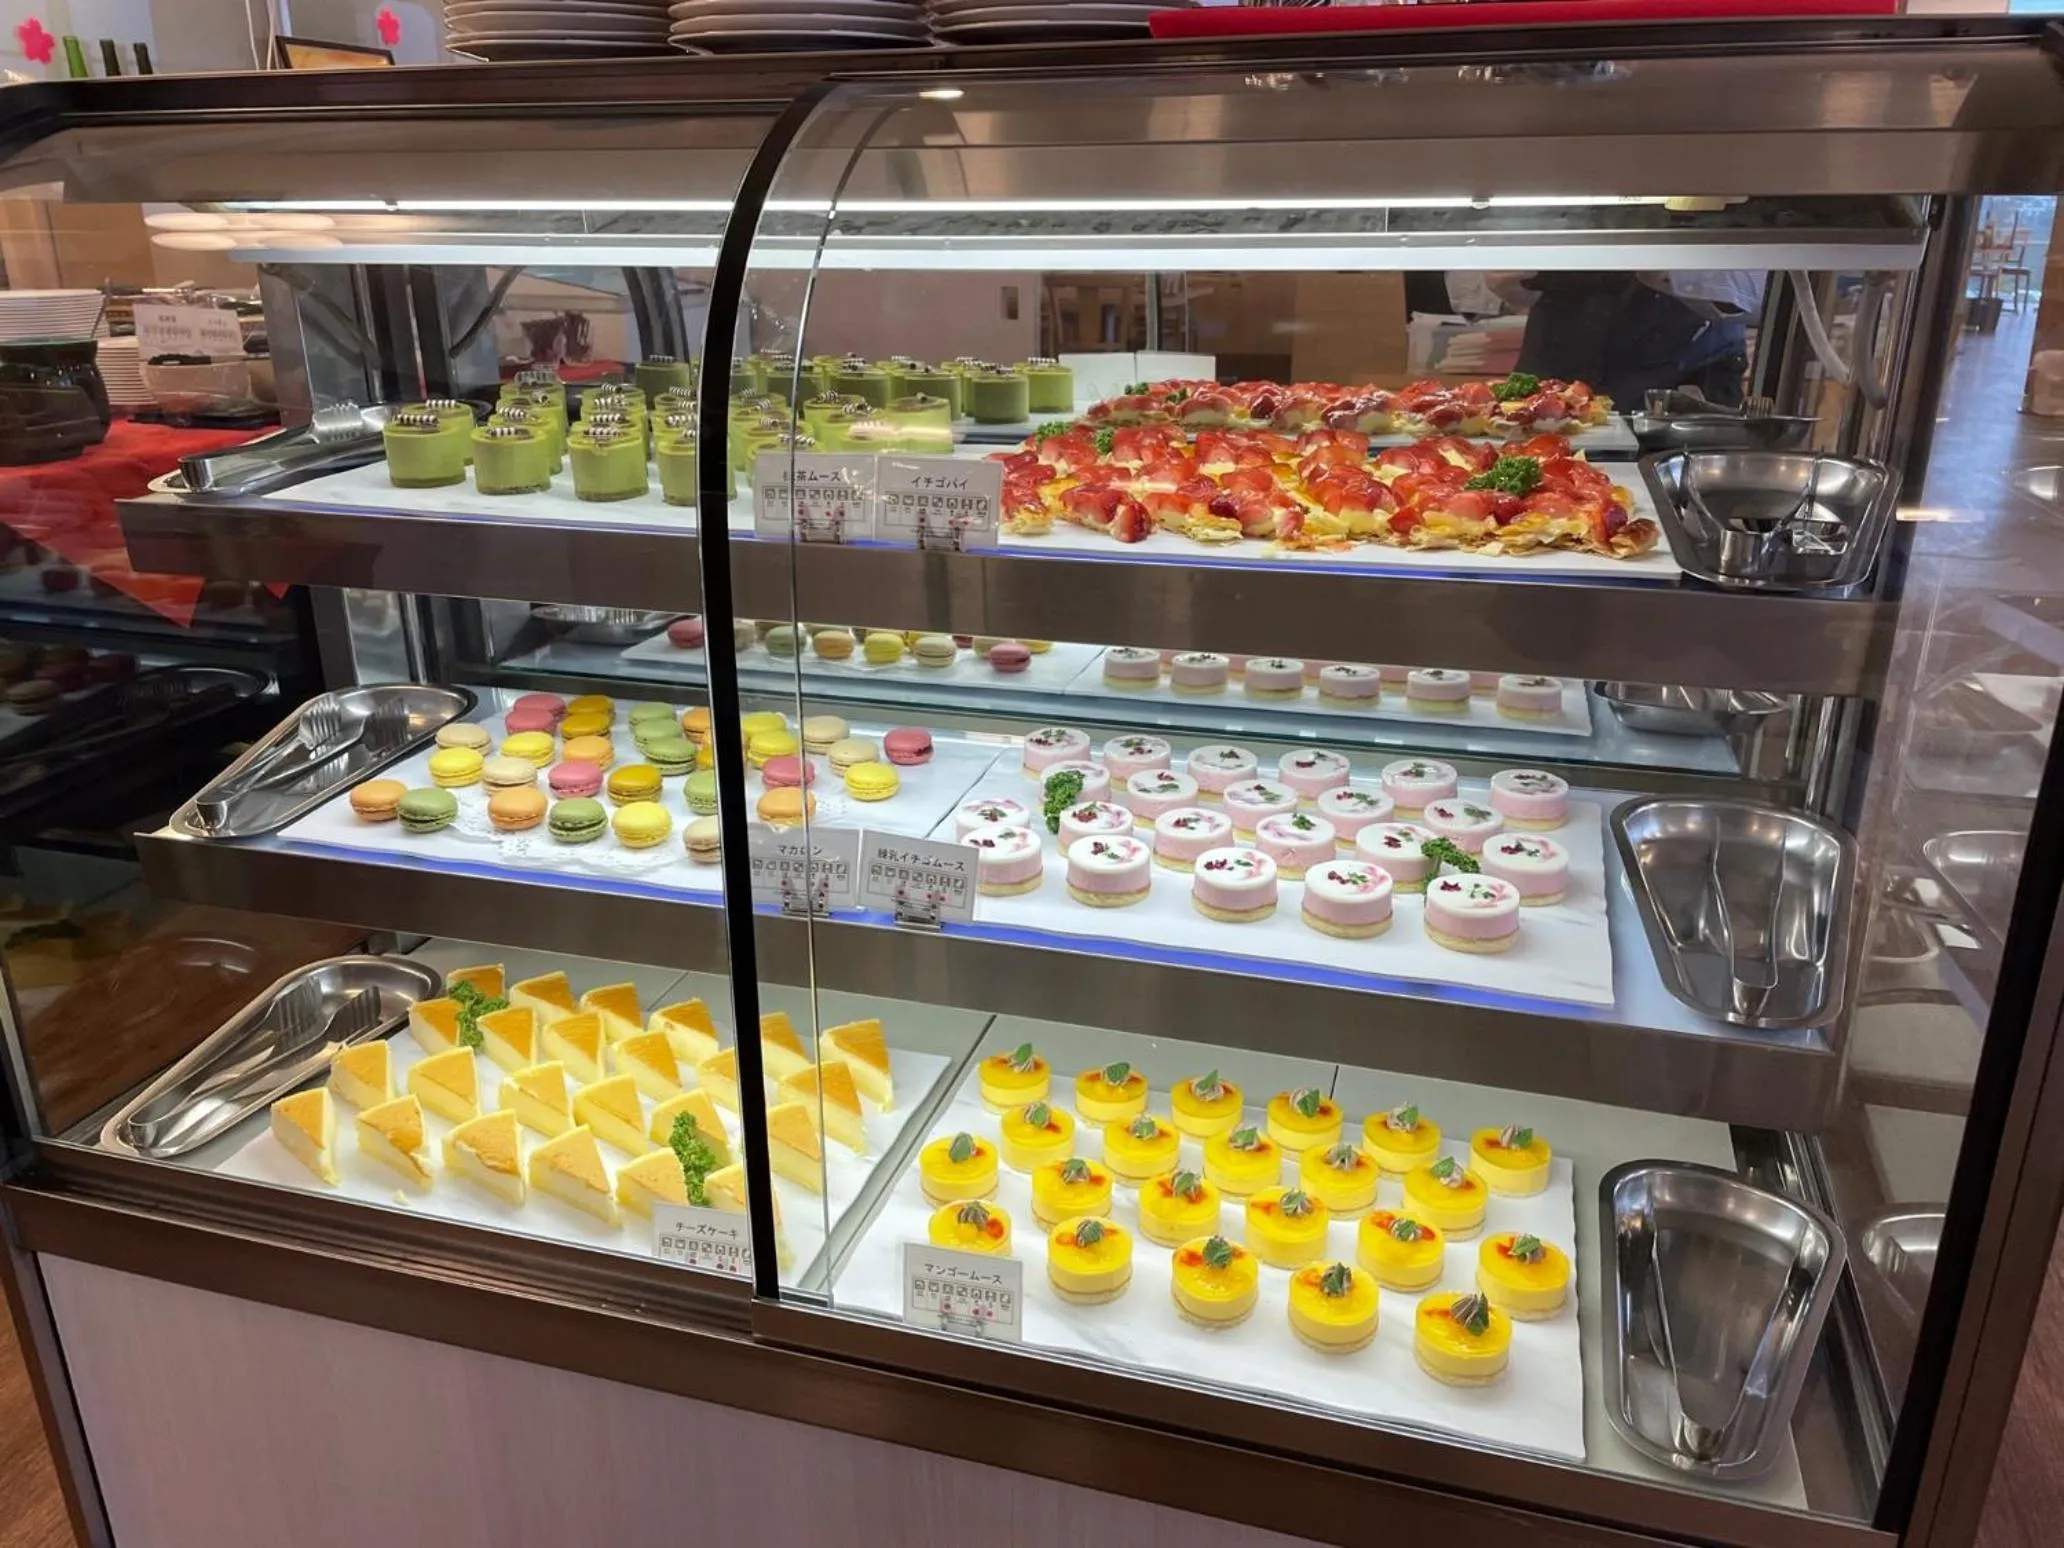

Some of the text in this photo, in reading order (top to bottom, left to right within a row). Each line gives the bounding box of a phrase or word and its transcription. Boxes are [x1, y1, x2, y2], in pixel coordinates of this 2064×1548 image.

[675, 1221, 738, 1241] チーズケーキ
[924, 1262, 1002, 1285] マンゴームース
